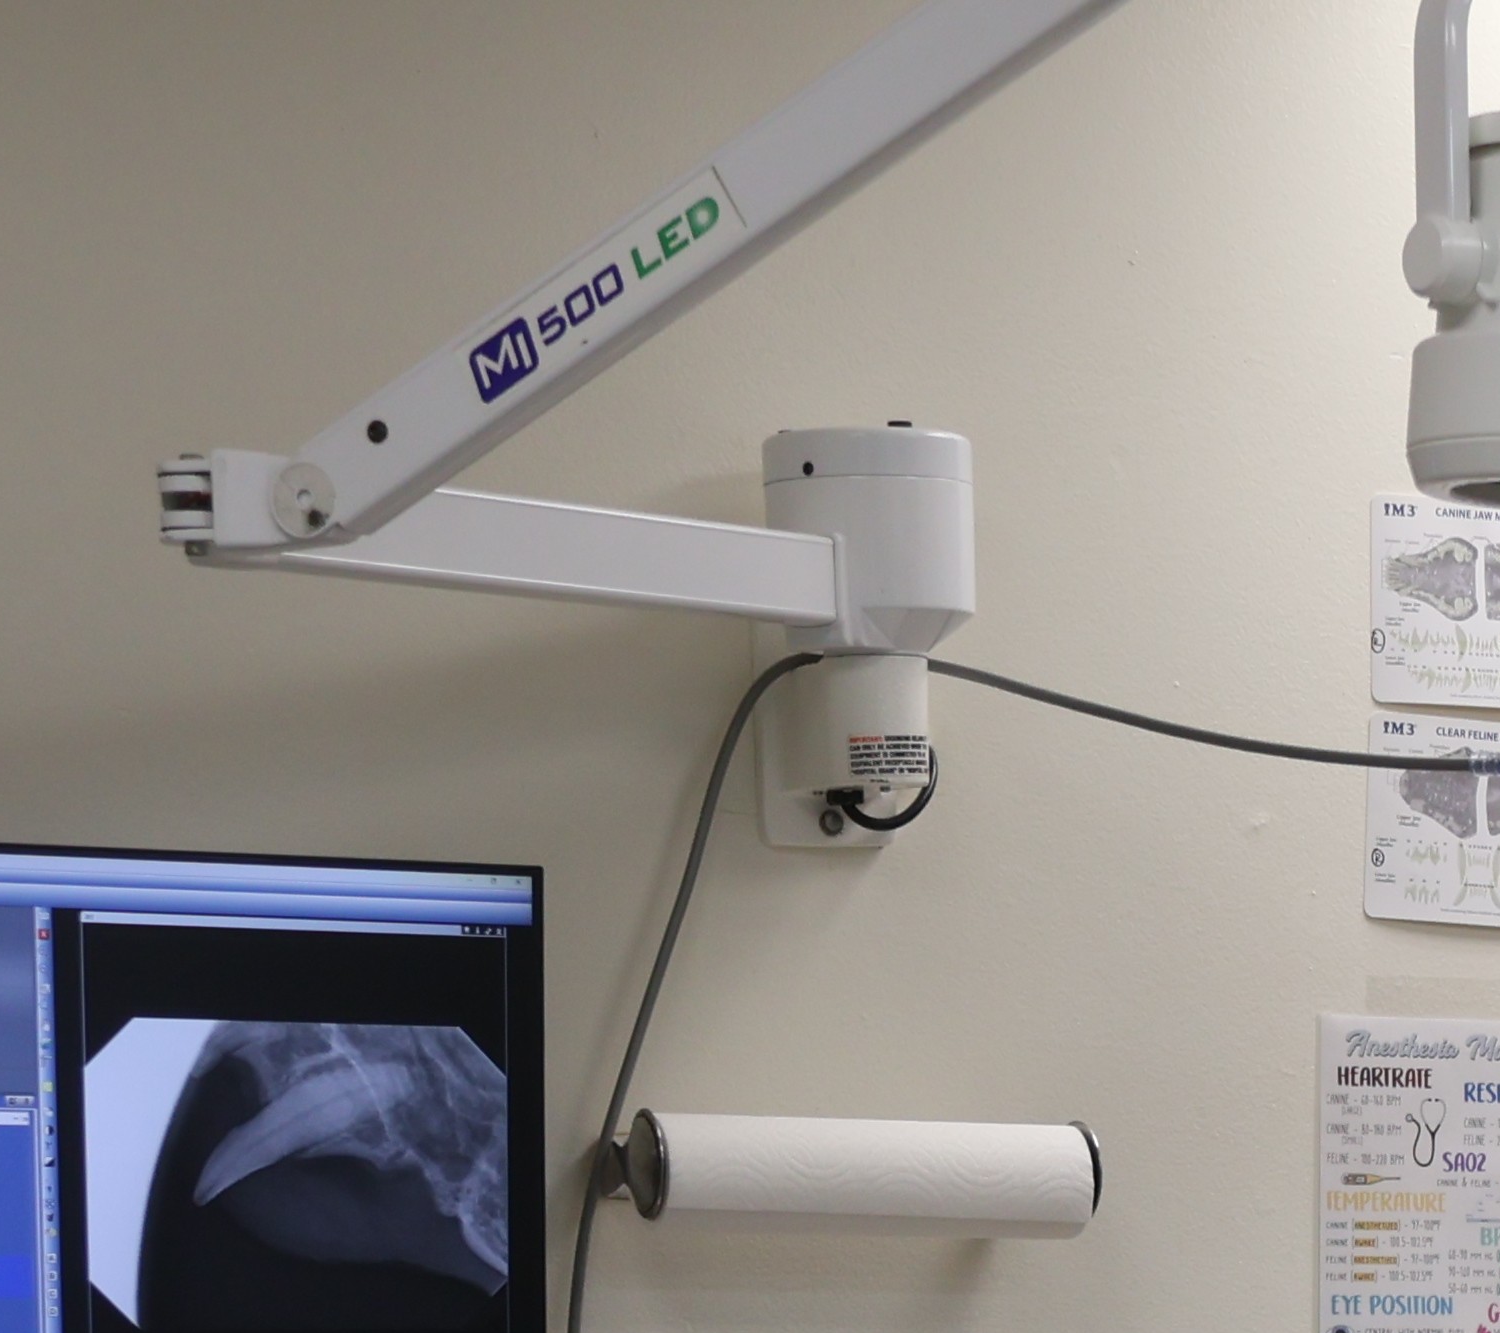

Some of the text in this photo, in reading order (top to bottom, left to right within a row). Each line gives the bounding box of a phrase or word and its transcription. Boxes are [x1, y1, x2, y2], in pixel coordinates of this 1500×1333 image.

[537, 264, 624, 346] 500
[631, 197, 719, 280] LED
[1384, 503, 1416, 517] IM3
[1436, 507, 1471, 520] CANINE
[1473, 509, 1493, 521] JAW
[1383, 721, 1415, 736] IM3
[1436, 726, 1466, 739] CLEAR
[1468, 729, 1499, 742] FELINE
[1346, 1029, 1460, 1060] Anesthesia
[1337, 1065, 1432, 1089] HEARTRATE
[1326, 1093, 1401, 1106] CANINE BPM
[1326, 1123, 1401, 1135] CANINE BPM
[1464, 1117, 1486, 1129] CANINE
[1464, 1134, 1485, 1146] FELINE
[1327, 1153, 1404, 1165] FELINE BPM
[1442, 1151, 1486, 1172] SAO2
[1326, 1190, 1446, 1213] TEMPERATURE
[1331, 1294, 1453, 1316] EYE POSITION
